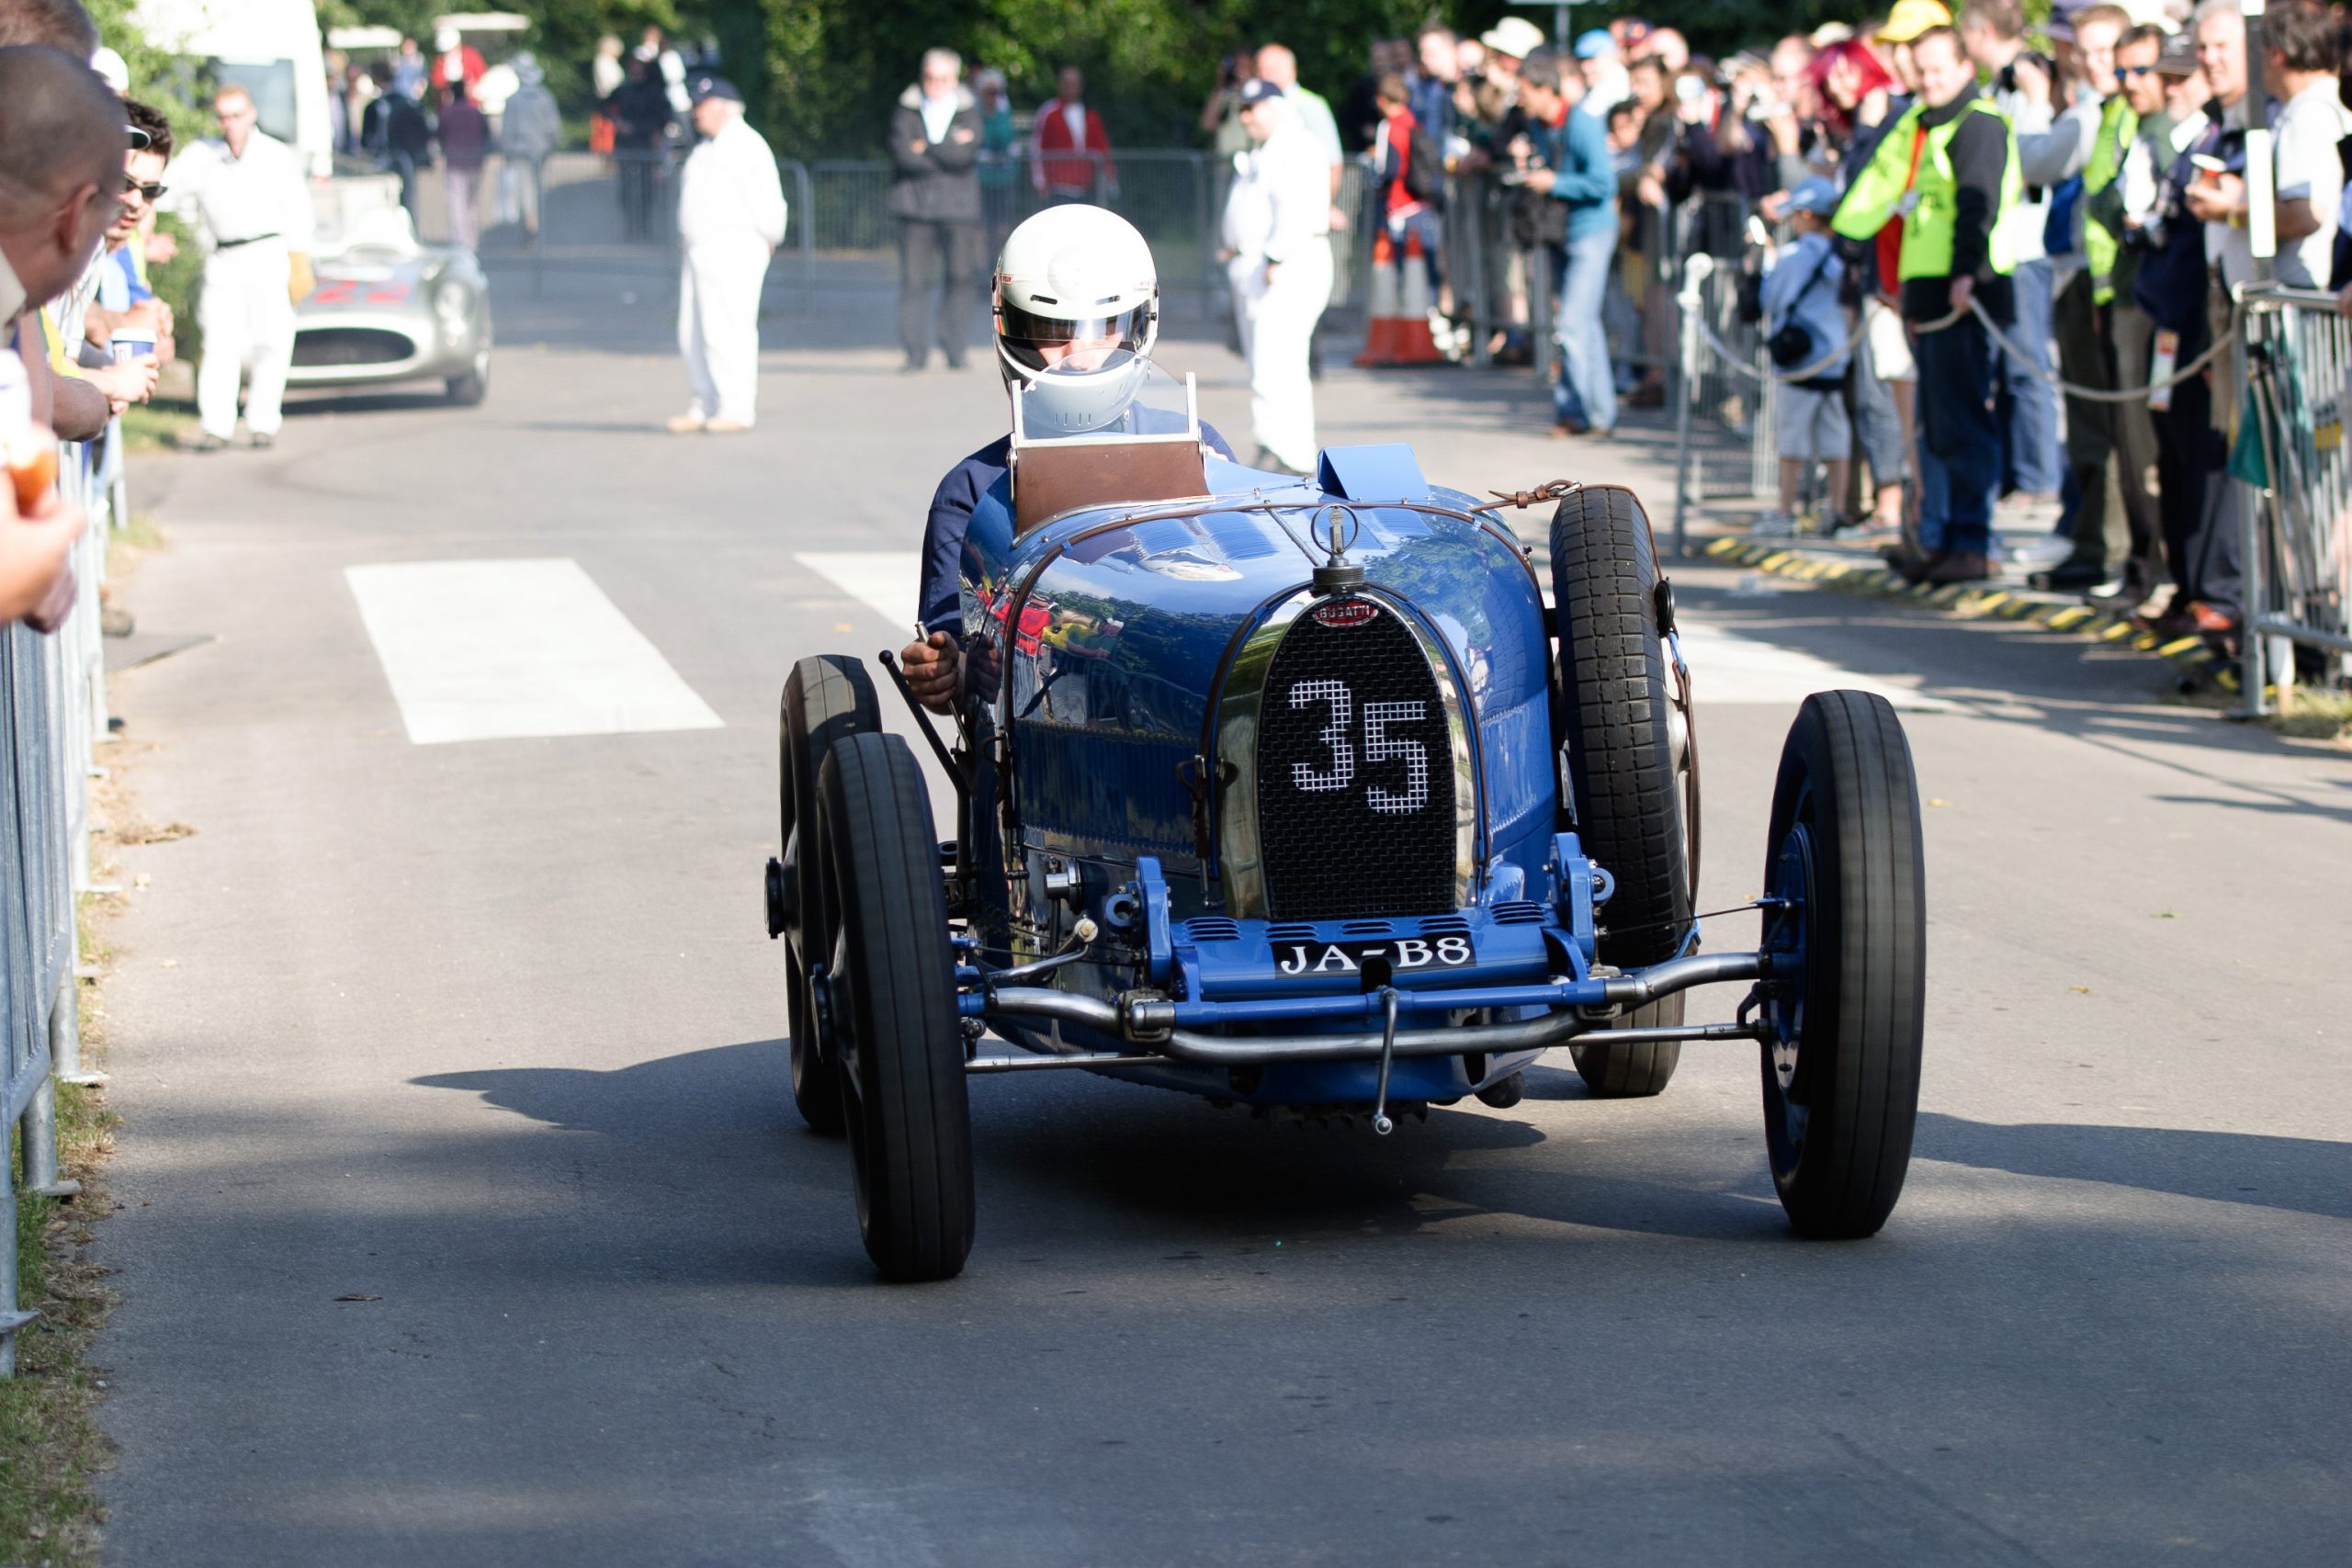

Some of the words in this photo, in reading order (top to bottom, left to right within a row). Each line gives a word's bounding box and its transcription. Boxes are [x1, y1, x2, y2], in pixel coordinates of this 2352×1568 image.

[1319, 604, 1370, 618] BUGATTI
[1288, 679, 1429, 814] 35
[1281, 937, 1470, 975] JA-B8
